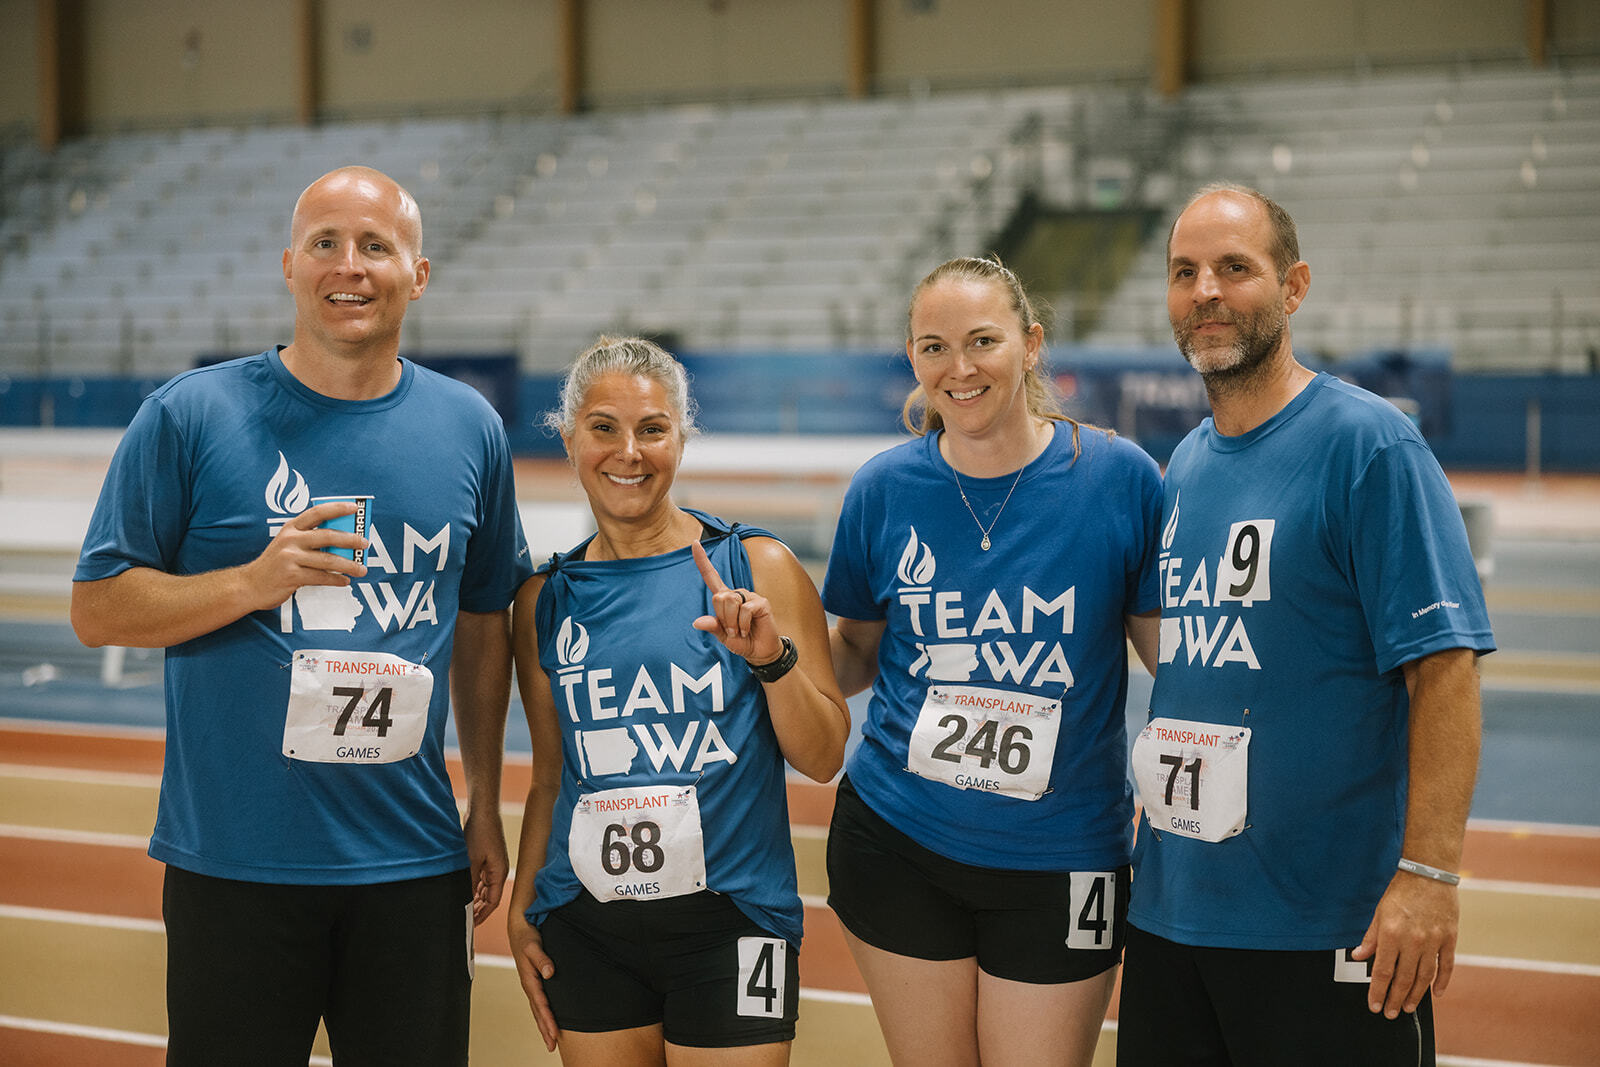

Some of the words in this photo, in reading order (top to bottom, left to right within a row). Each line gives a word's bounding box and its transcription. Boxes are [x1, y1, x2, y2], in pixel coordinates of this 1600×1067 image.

[355, 501, 366, 566] POERADE
[1229, 524, 1260, 597] 9
[899, 585, 1075, 639] TEAM
[325, 660, 407, 676] TRANSPLANT
[559, 661, 724, 722] TEAM
[332, 687, 393, 737] 74
[954, 695, 1034, 716] TRANSPLANT
[336, 746, 380, 759] GAMES
[931, 714, 1034, 775] 246
[1156, 728, 1221, 747] TRANSPLANT
[595, 795, 670, 812] TRANSPLANT
[955, 774, 1000, 791] GAMES
[1160, 754, 1202, 811] 71
[601, 821, 665, 876] 68
[1171, 816, 1200, 833] GAMES
[614, 882, 660, 896] GAMES
[1078, 876, 1107, 945] 4
[747, 942, 777, 1013] 4
